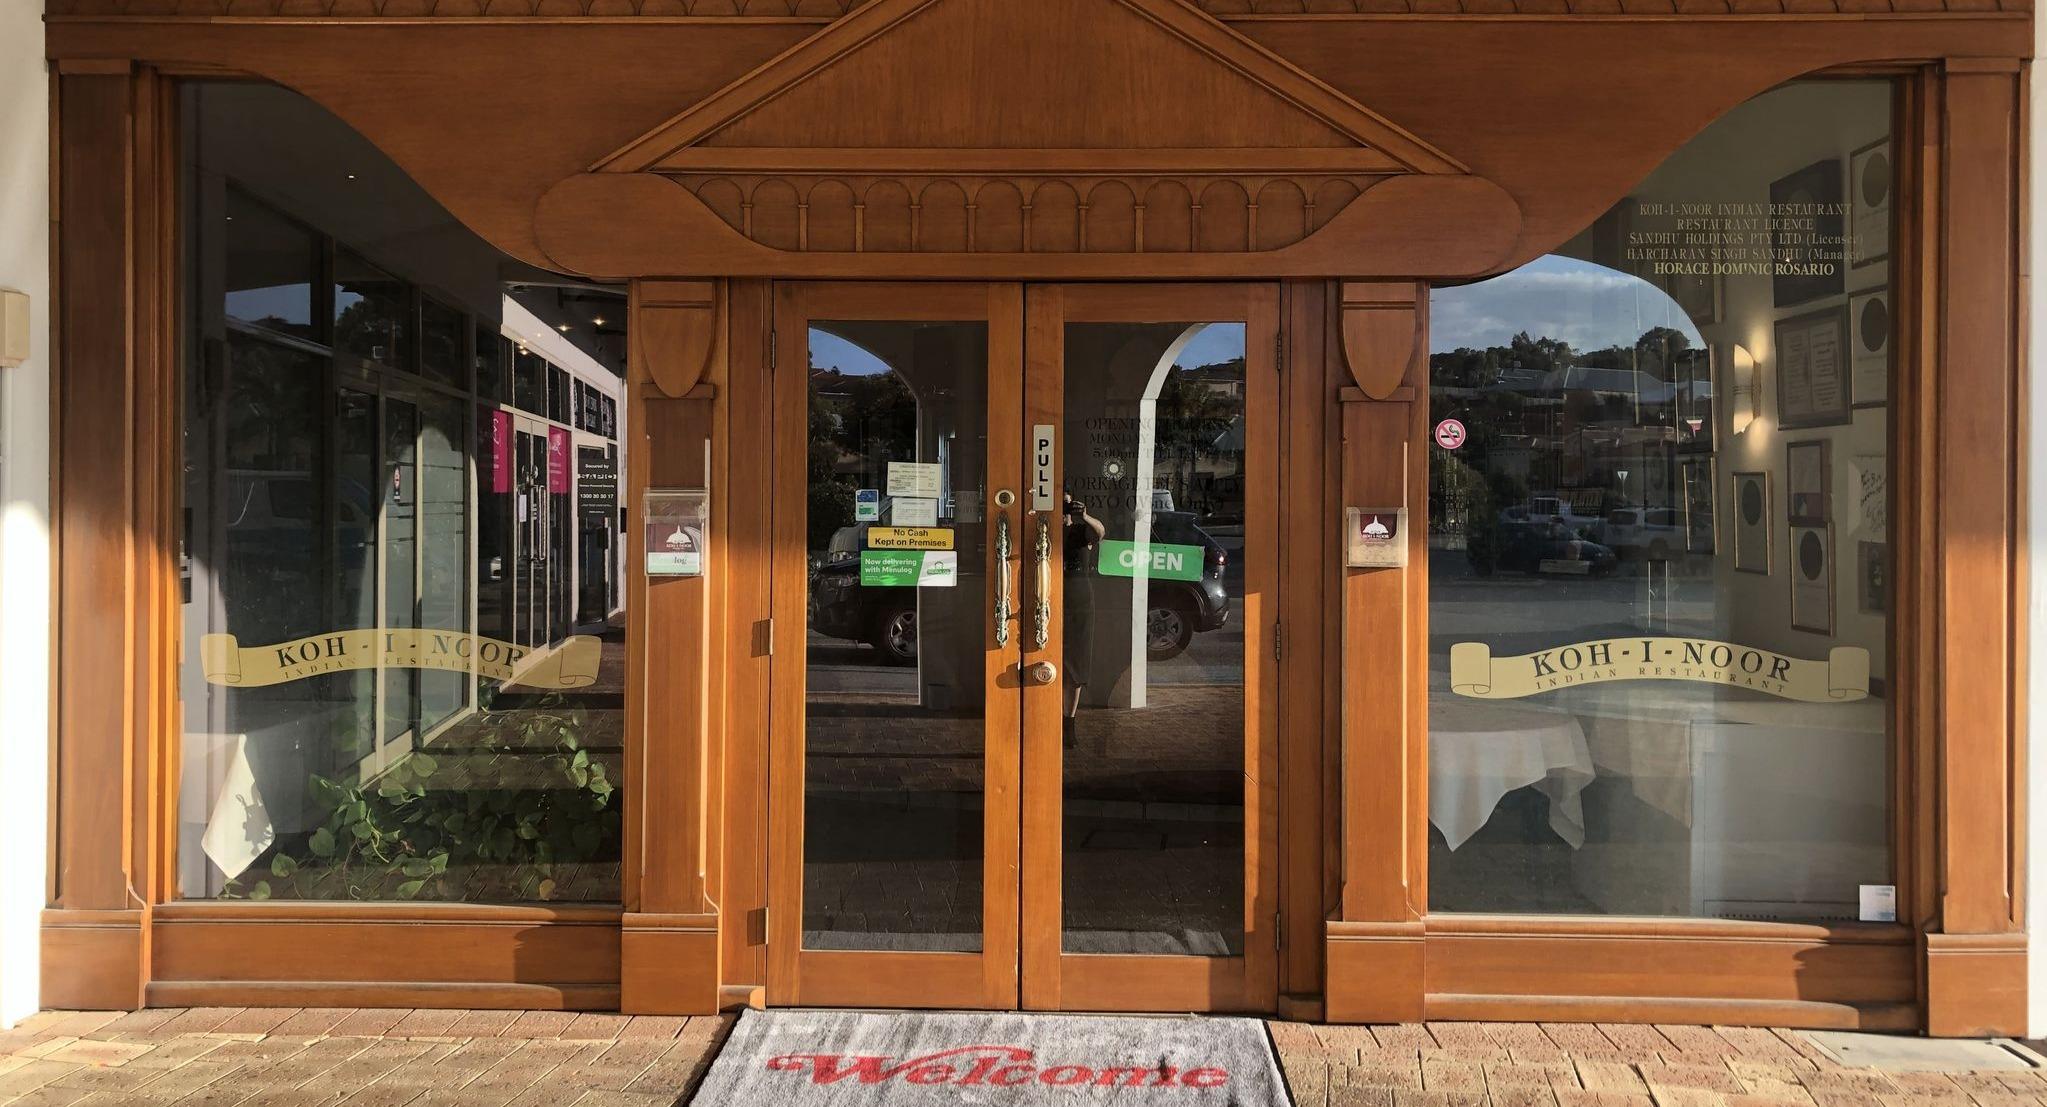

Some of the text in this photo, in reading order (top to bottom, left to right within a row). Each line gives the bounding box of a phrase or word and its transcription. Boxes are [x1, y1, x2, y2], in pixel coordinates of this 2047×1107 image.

[1718, 203, 1763, 215] INDIAN
[1769, 203, 1852, 215] RESTAURANT
[1677, 218, 1815, 231] RESTAURANT LICENCE
[1629, 232, 1680, 245] SANDHU
[1686, 233, 1744, 245] HOLDINGS
[1750, 232, 1773, 245] PTY
[1780, 232, 1803, 245] LTD
[1627, 248, 1706, 260] HARCHARAN
[1711, 248, 1747, 260] SINGH
[1752, 248, 1803, 260] SANDHU
[1654, 262, 1710, 275] HORACE
[1775, 262, 1834, 275] ROSARIO
[1038, 438, 1049, 498] PULL
[1066, 476, 1138, 490] ORKAGE
[893, 528, 929, 537] No Cash
[875, 537, 895, 547] Kept
[909, 538, 947, 547] Premises
[882, 558, 917, 567] delivering
[1118, 549, 1183, 572] OPEN
[881, 566, 913, 575] Menulog
[1530, 640, 1791, 682] KOH-I-NOOR
[1536, 667, 1789, 693] INDIAN RESTAURANT
[767, 1045, 1229, 1088] Welcome
